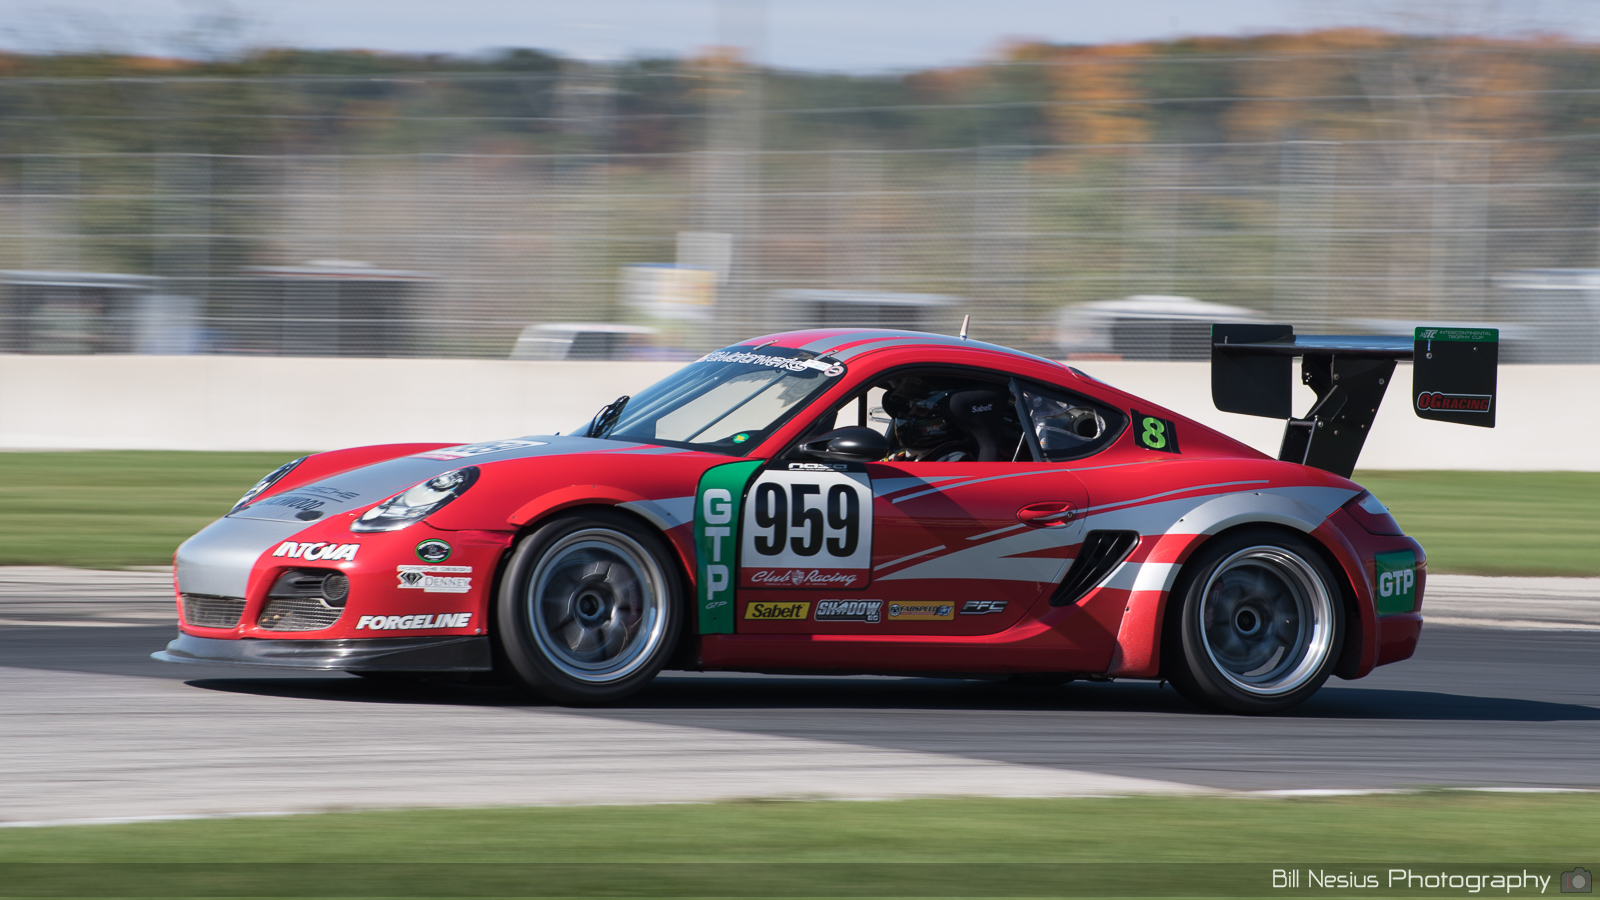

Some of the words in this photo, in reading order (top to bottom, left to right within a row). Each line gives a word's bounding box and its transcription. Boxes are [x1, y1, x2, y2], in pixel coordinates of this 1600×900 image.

[1142, 417, 1166, 449] 8
[754, 482, 860, 557] 959
[272, 541, 361, 561] INTOVA
[703, 488, 732, 600] GTP
[751, 570, 792, 583] Club
[803, 569, 857, 587] Racing
[1380, 568, 1414, 597] GTP
[751, 603, 803, 618] Sabelt
[817, 601, 881, 616] SHADOW
[963, 600, 1008, 611] PFC
[355, 612, 473, 631] FORGELINE
